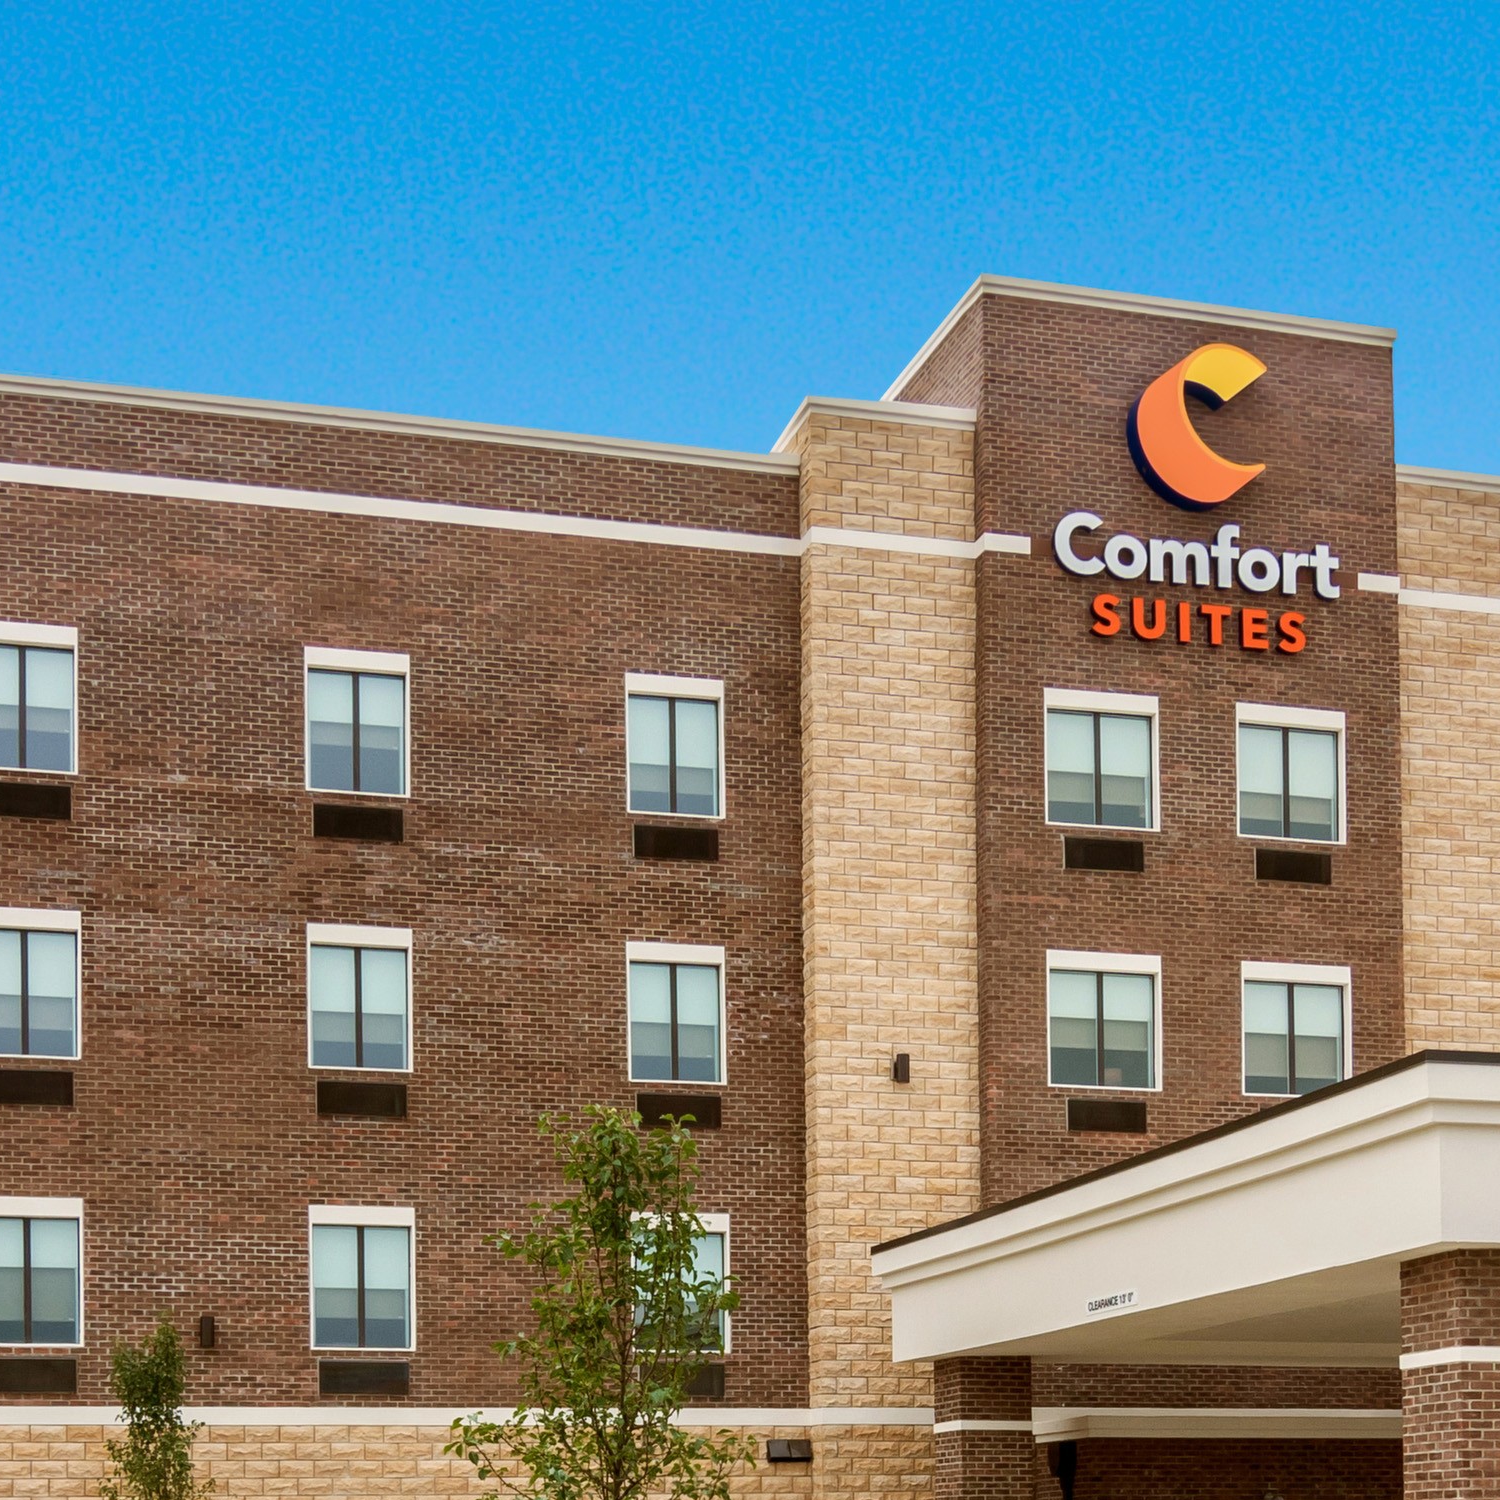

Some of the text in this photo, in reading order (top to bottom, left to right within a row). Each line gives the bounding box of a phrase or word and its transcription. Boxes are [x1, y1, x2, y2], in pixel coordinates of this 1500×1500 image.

[1053, 511, 1340, 599] Comfort
[1091, 594, 1306, 653] SUITES
[1088, 1295, 1118, 1311] CLEARANCE
